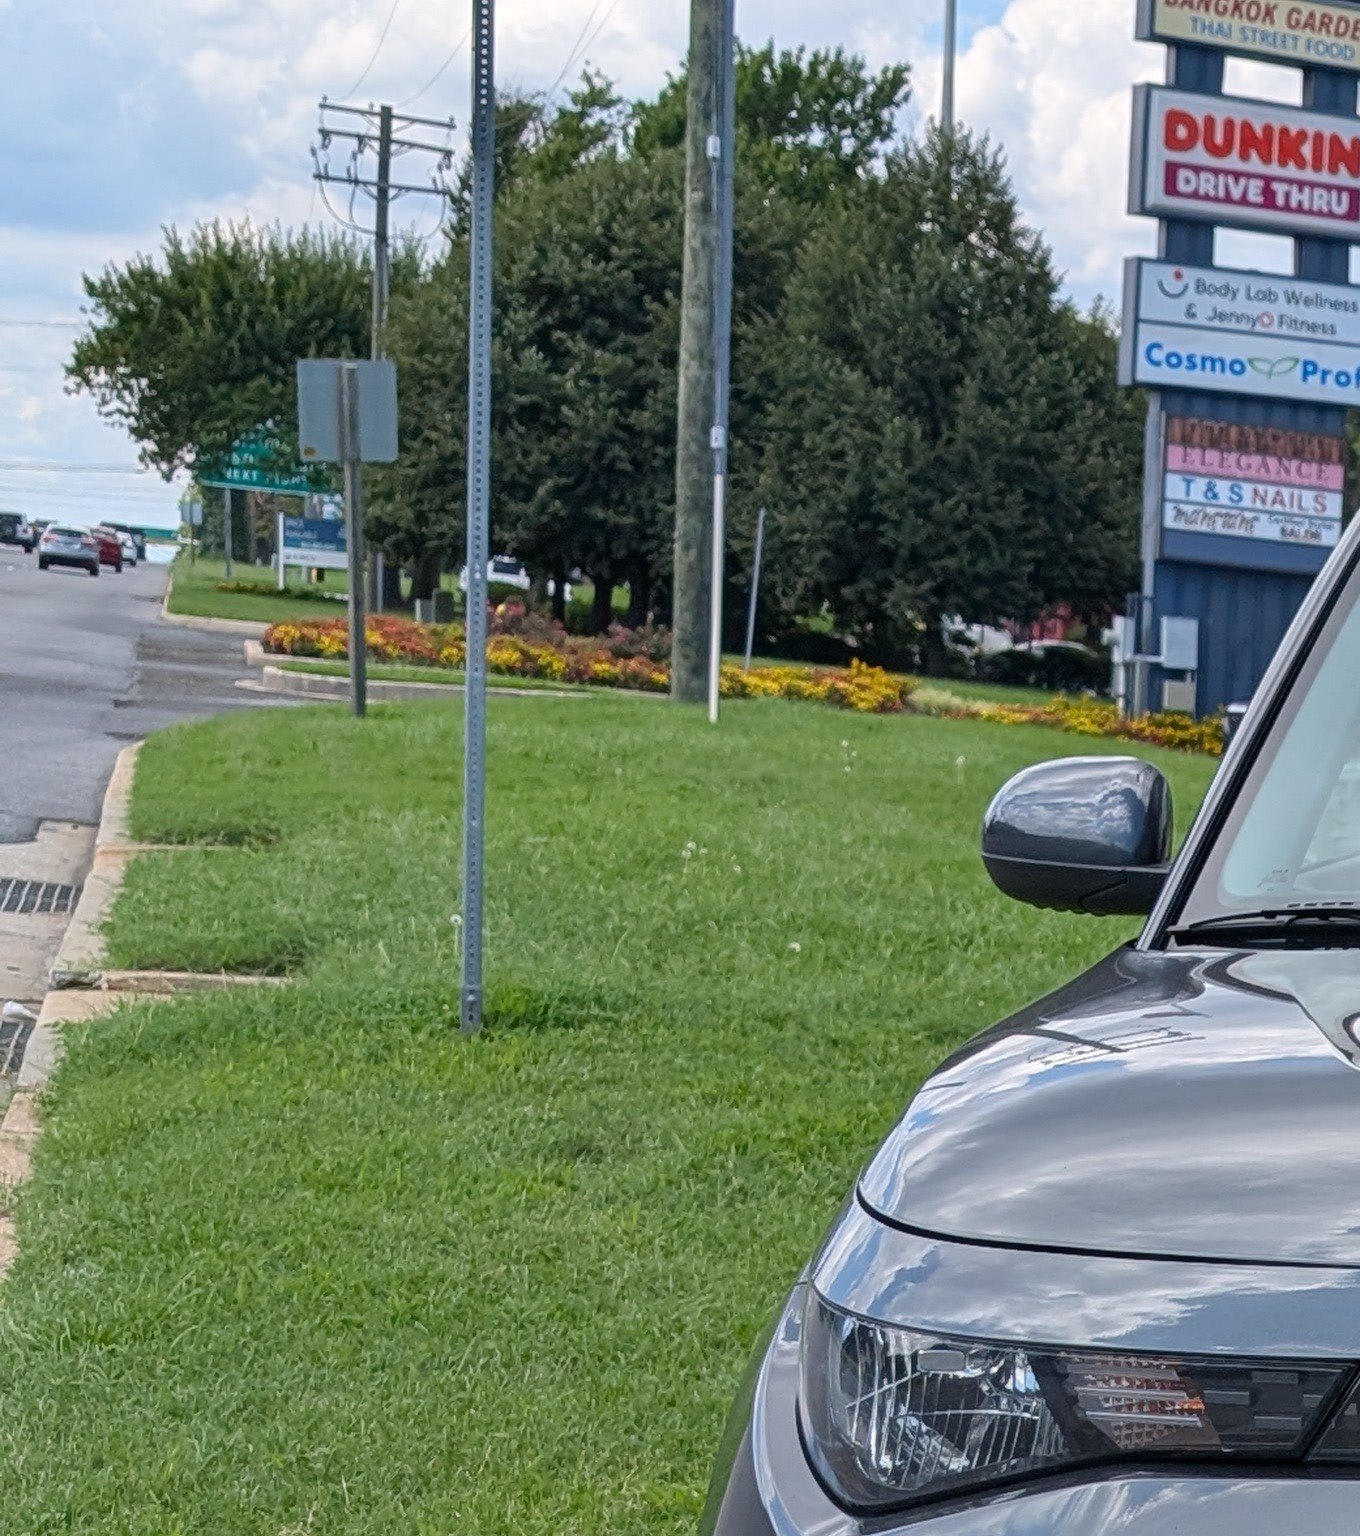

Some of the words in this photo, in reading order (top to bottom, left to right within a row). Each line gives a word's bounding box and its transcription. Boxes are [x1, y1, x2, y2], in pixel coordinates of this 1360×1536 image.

[1190, 15, 1233, 40] THAI
[1239, 25, 1300, 51] STREET
[1305, 37, 1356, 61] FOOD
[1175, 168, 1265, 205] DRIVE
[1271, 186, 1350, 215] THRU
[1194, 277, 1239, 301] Body
[1245, 283, 1279, 303] Lab
[1283, 289, 1359, 314] Wellness
[1184, 302, 1197, 320] &
[1277, 313, 1338, 336] Fitness
[1144, 342, 1247, 376] Cosmo
[1181, 449, 1329, 482] ELEGANCE
[1182, 477, 1196, 497] T
[1203, 480, 1219, 501] &
[1229, 482, 1244, 504] S
[1252, 486, 1328, 514] NAILS
